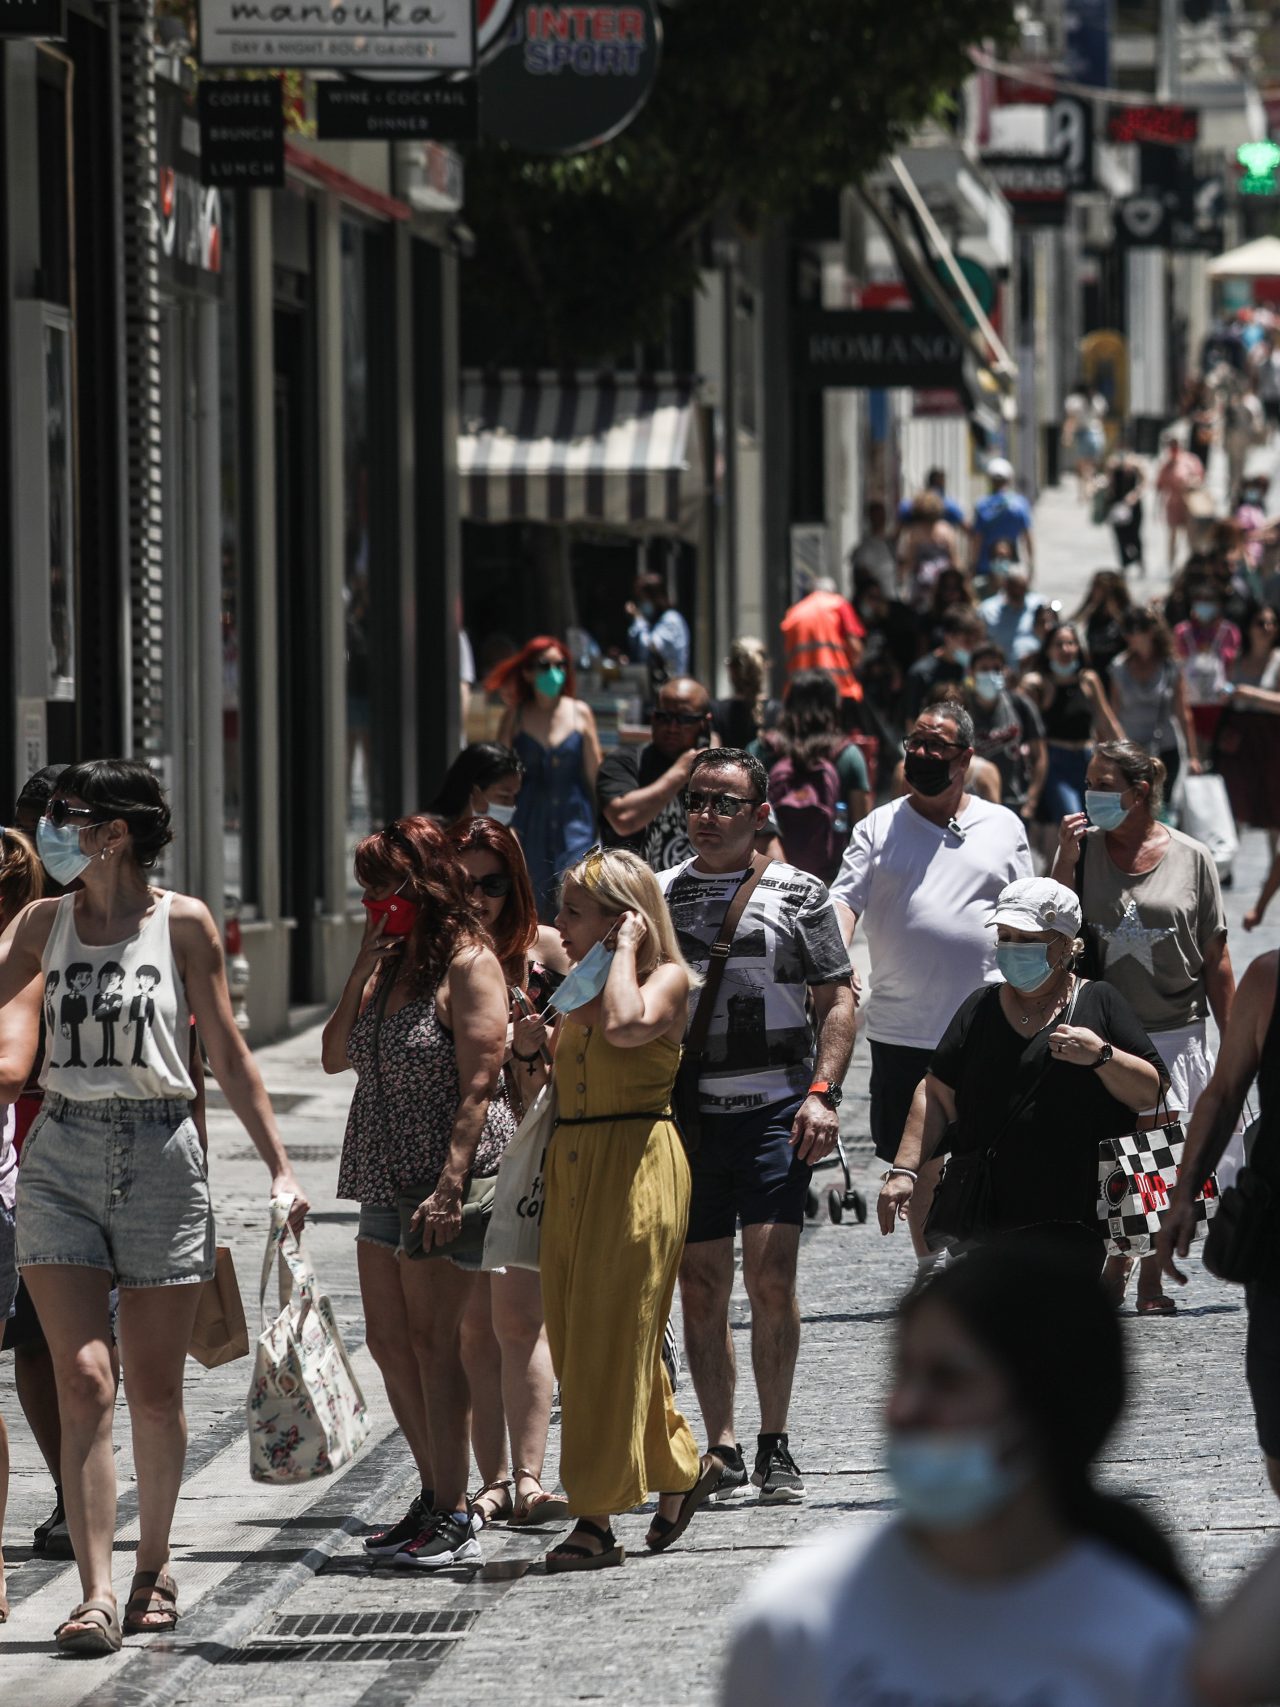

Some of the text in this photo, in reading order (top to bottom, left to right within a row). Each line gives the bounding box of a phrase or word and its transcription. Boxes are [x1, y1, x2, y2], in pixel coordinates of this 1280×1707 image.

[230, 0, 445, 29] manouka
[526, 6, 646, 42] INTER
[231, 40, 259, 55] DAY
[262, 40, 273, 55] &
[278, 40, 323, 56] NIGHT
[524, 41, 645, 76] SPORT
[208, 92, 272, 107] COFFEE
[329, 91, 468, 106] WINE COCKTAIL
[366, 116, 429, 131] DINNER
[209, 126, 274, 142] BRUNCH
[210, 161, 275, 177] LUNCH
[808, 333, 961, 364] ROMANO
